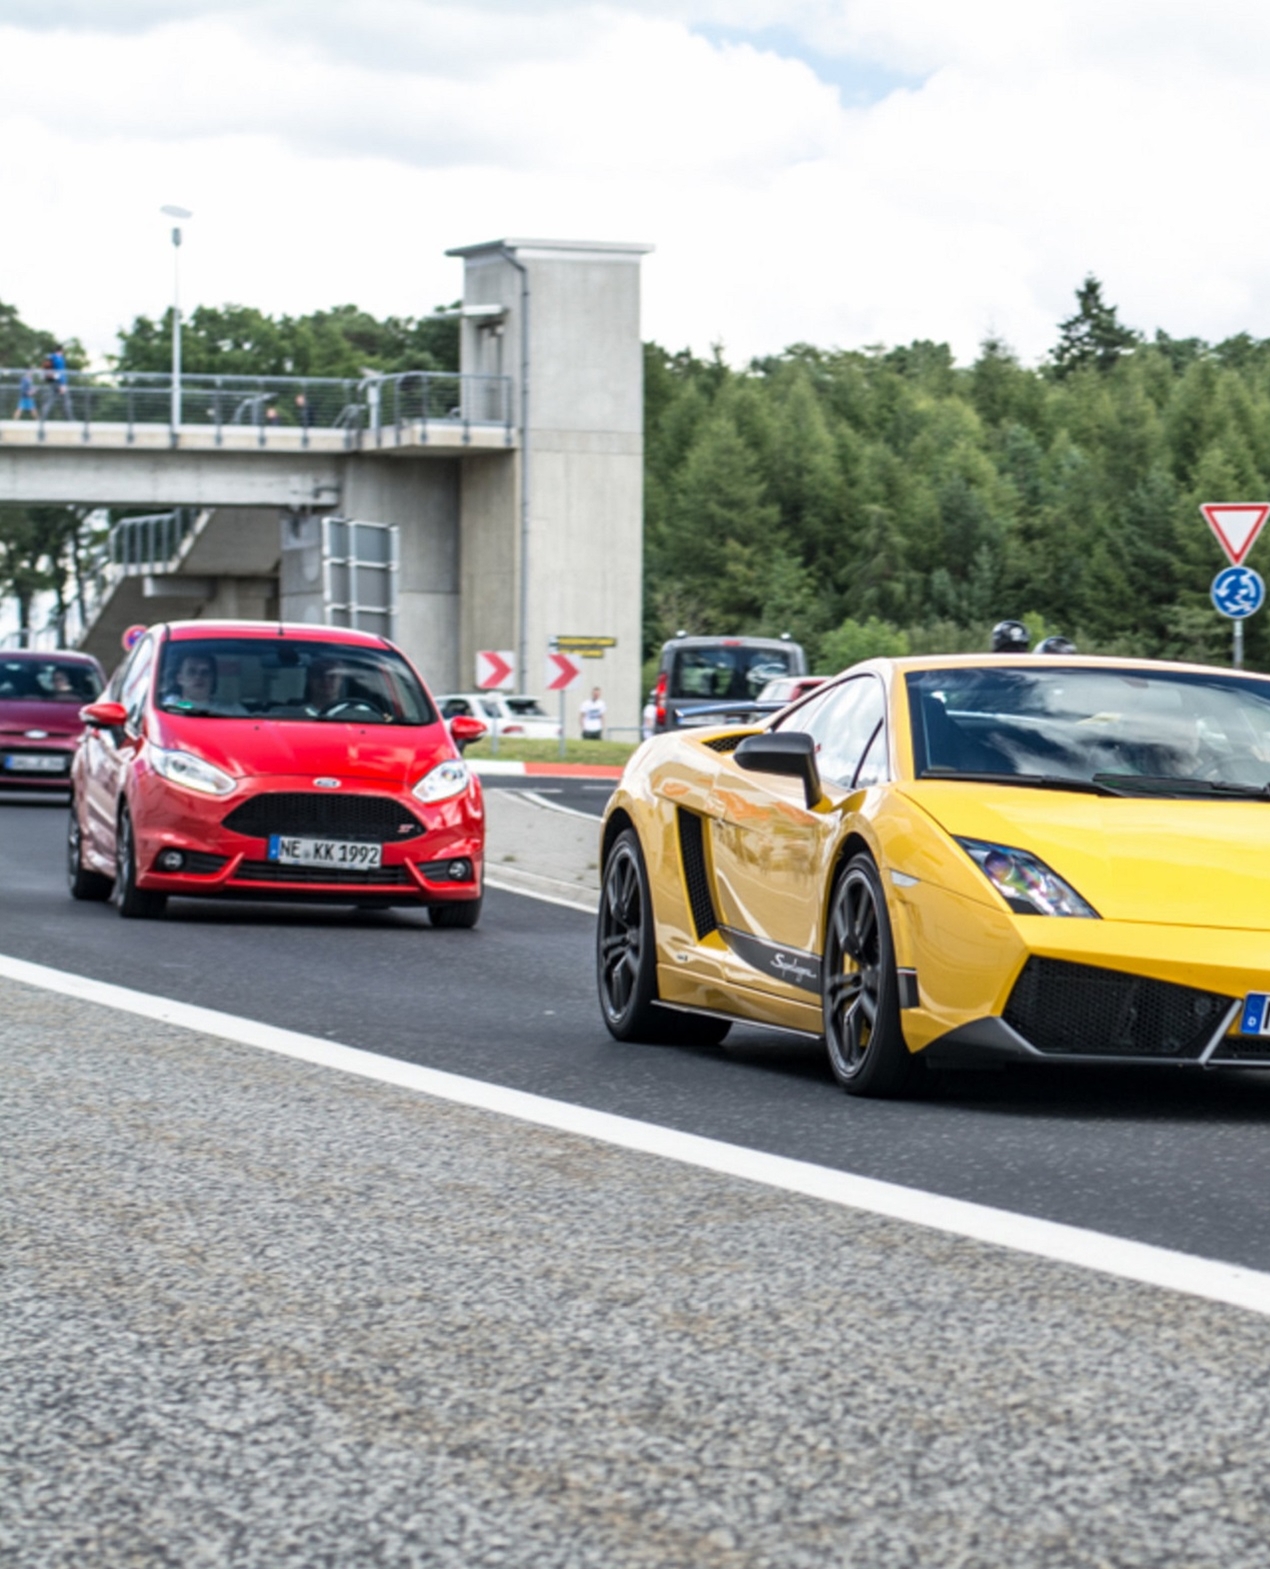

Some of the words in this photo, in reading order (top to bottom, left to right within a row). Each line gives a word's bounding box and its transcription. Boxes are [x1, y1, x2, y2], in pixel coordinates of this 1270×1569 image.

[280, 840, 301, 858] NE
[312, 842, 335, 860] KK
[338, 844, 380, 865] 1992
